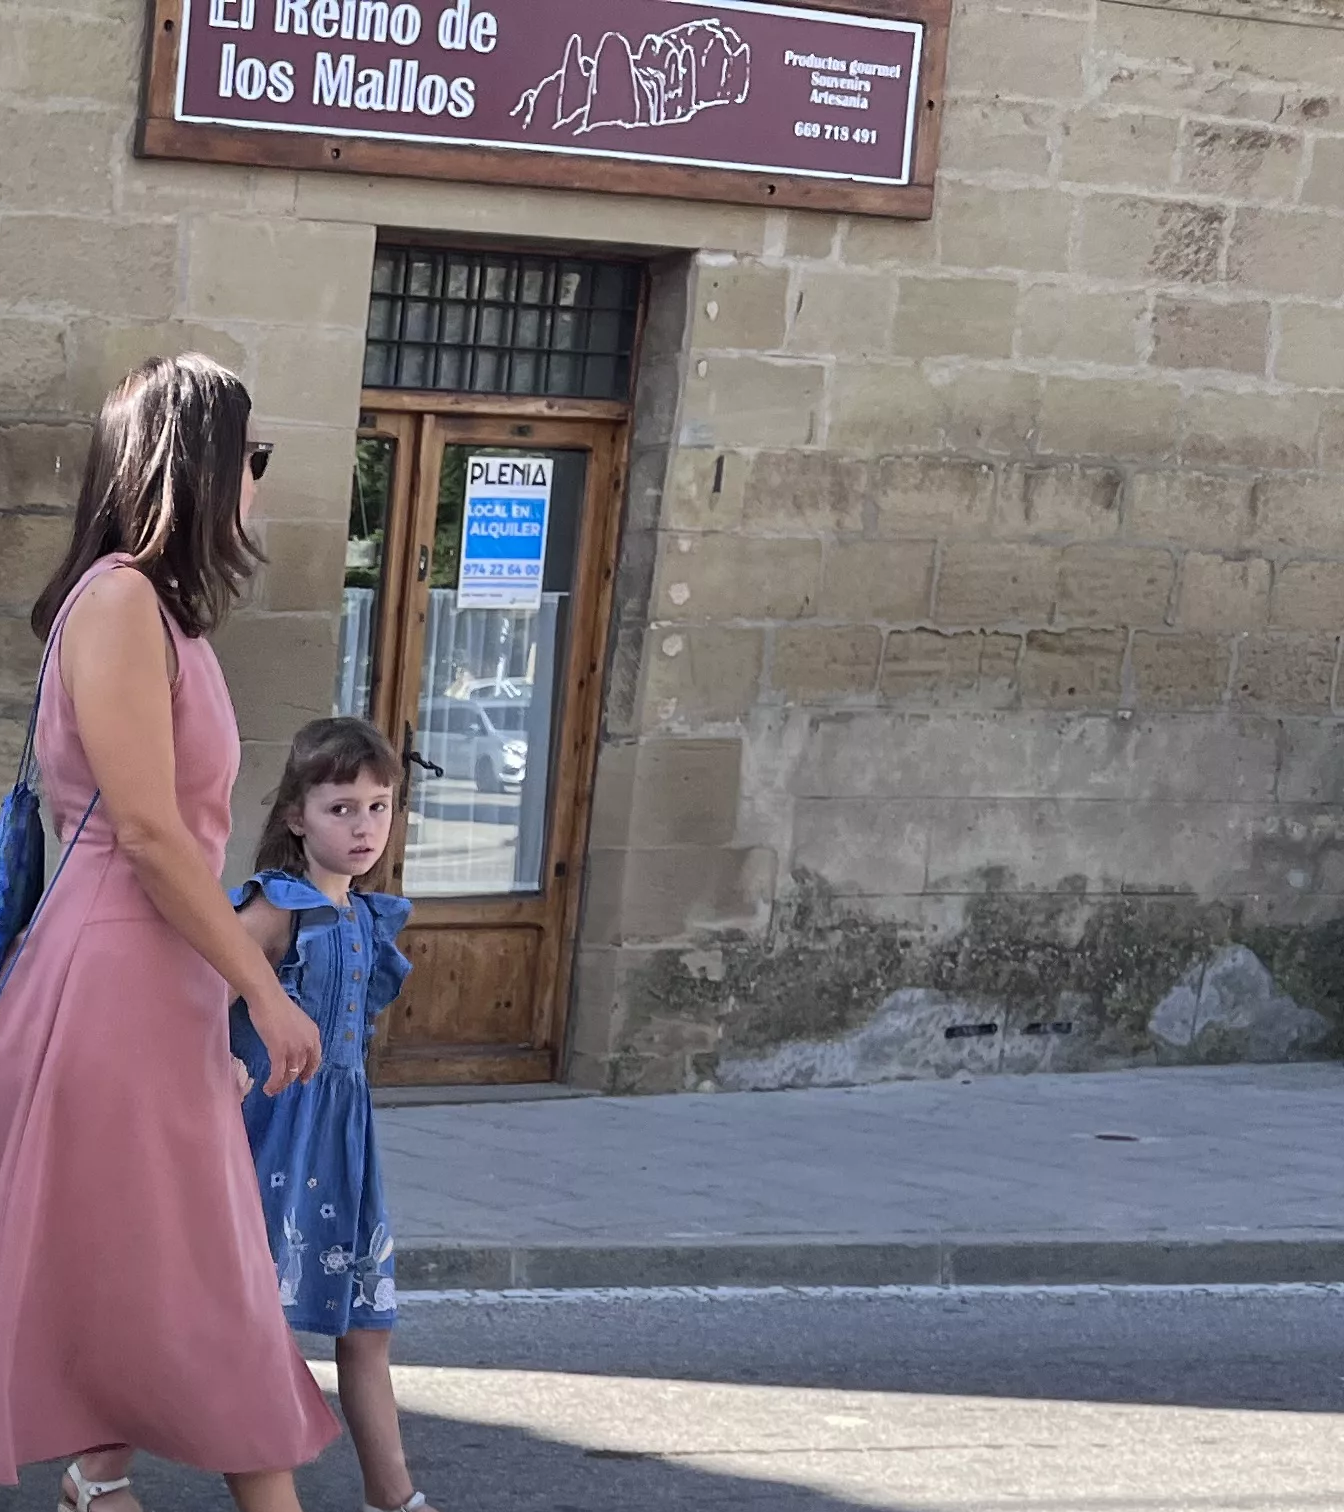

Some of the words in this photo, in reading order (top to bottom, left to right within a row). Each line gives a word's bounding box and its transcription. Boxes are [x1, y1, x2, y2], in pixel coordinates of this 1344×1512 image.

[274, 0, 422, 46] Reino
[437, 0, 498, 53] de
[784, 50, 847, 72] Productos
[849, 60, 901, 79] gourmet
[218, 43, 295, 103] los
[312, 51, 476, 118] Mallos
[810, 71, 871, 92] Souvenirs
[794, 121, 821, 138] 669
[824, 124, 850, 141] 718
[852, 128, 877, 144] 491
[470, 462, 547, 487] PLENIA
[467, 503, 509, 518] LOCAL
[512, 504, 531, 518] EN
[469, 521, 541, 538] ALQUILER
[464, 563, 486, 576] 974
[489, 564, 504, 576] 22
[507, 564, 522, 576] 64
[525, 564, 540, 576] 00
